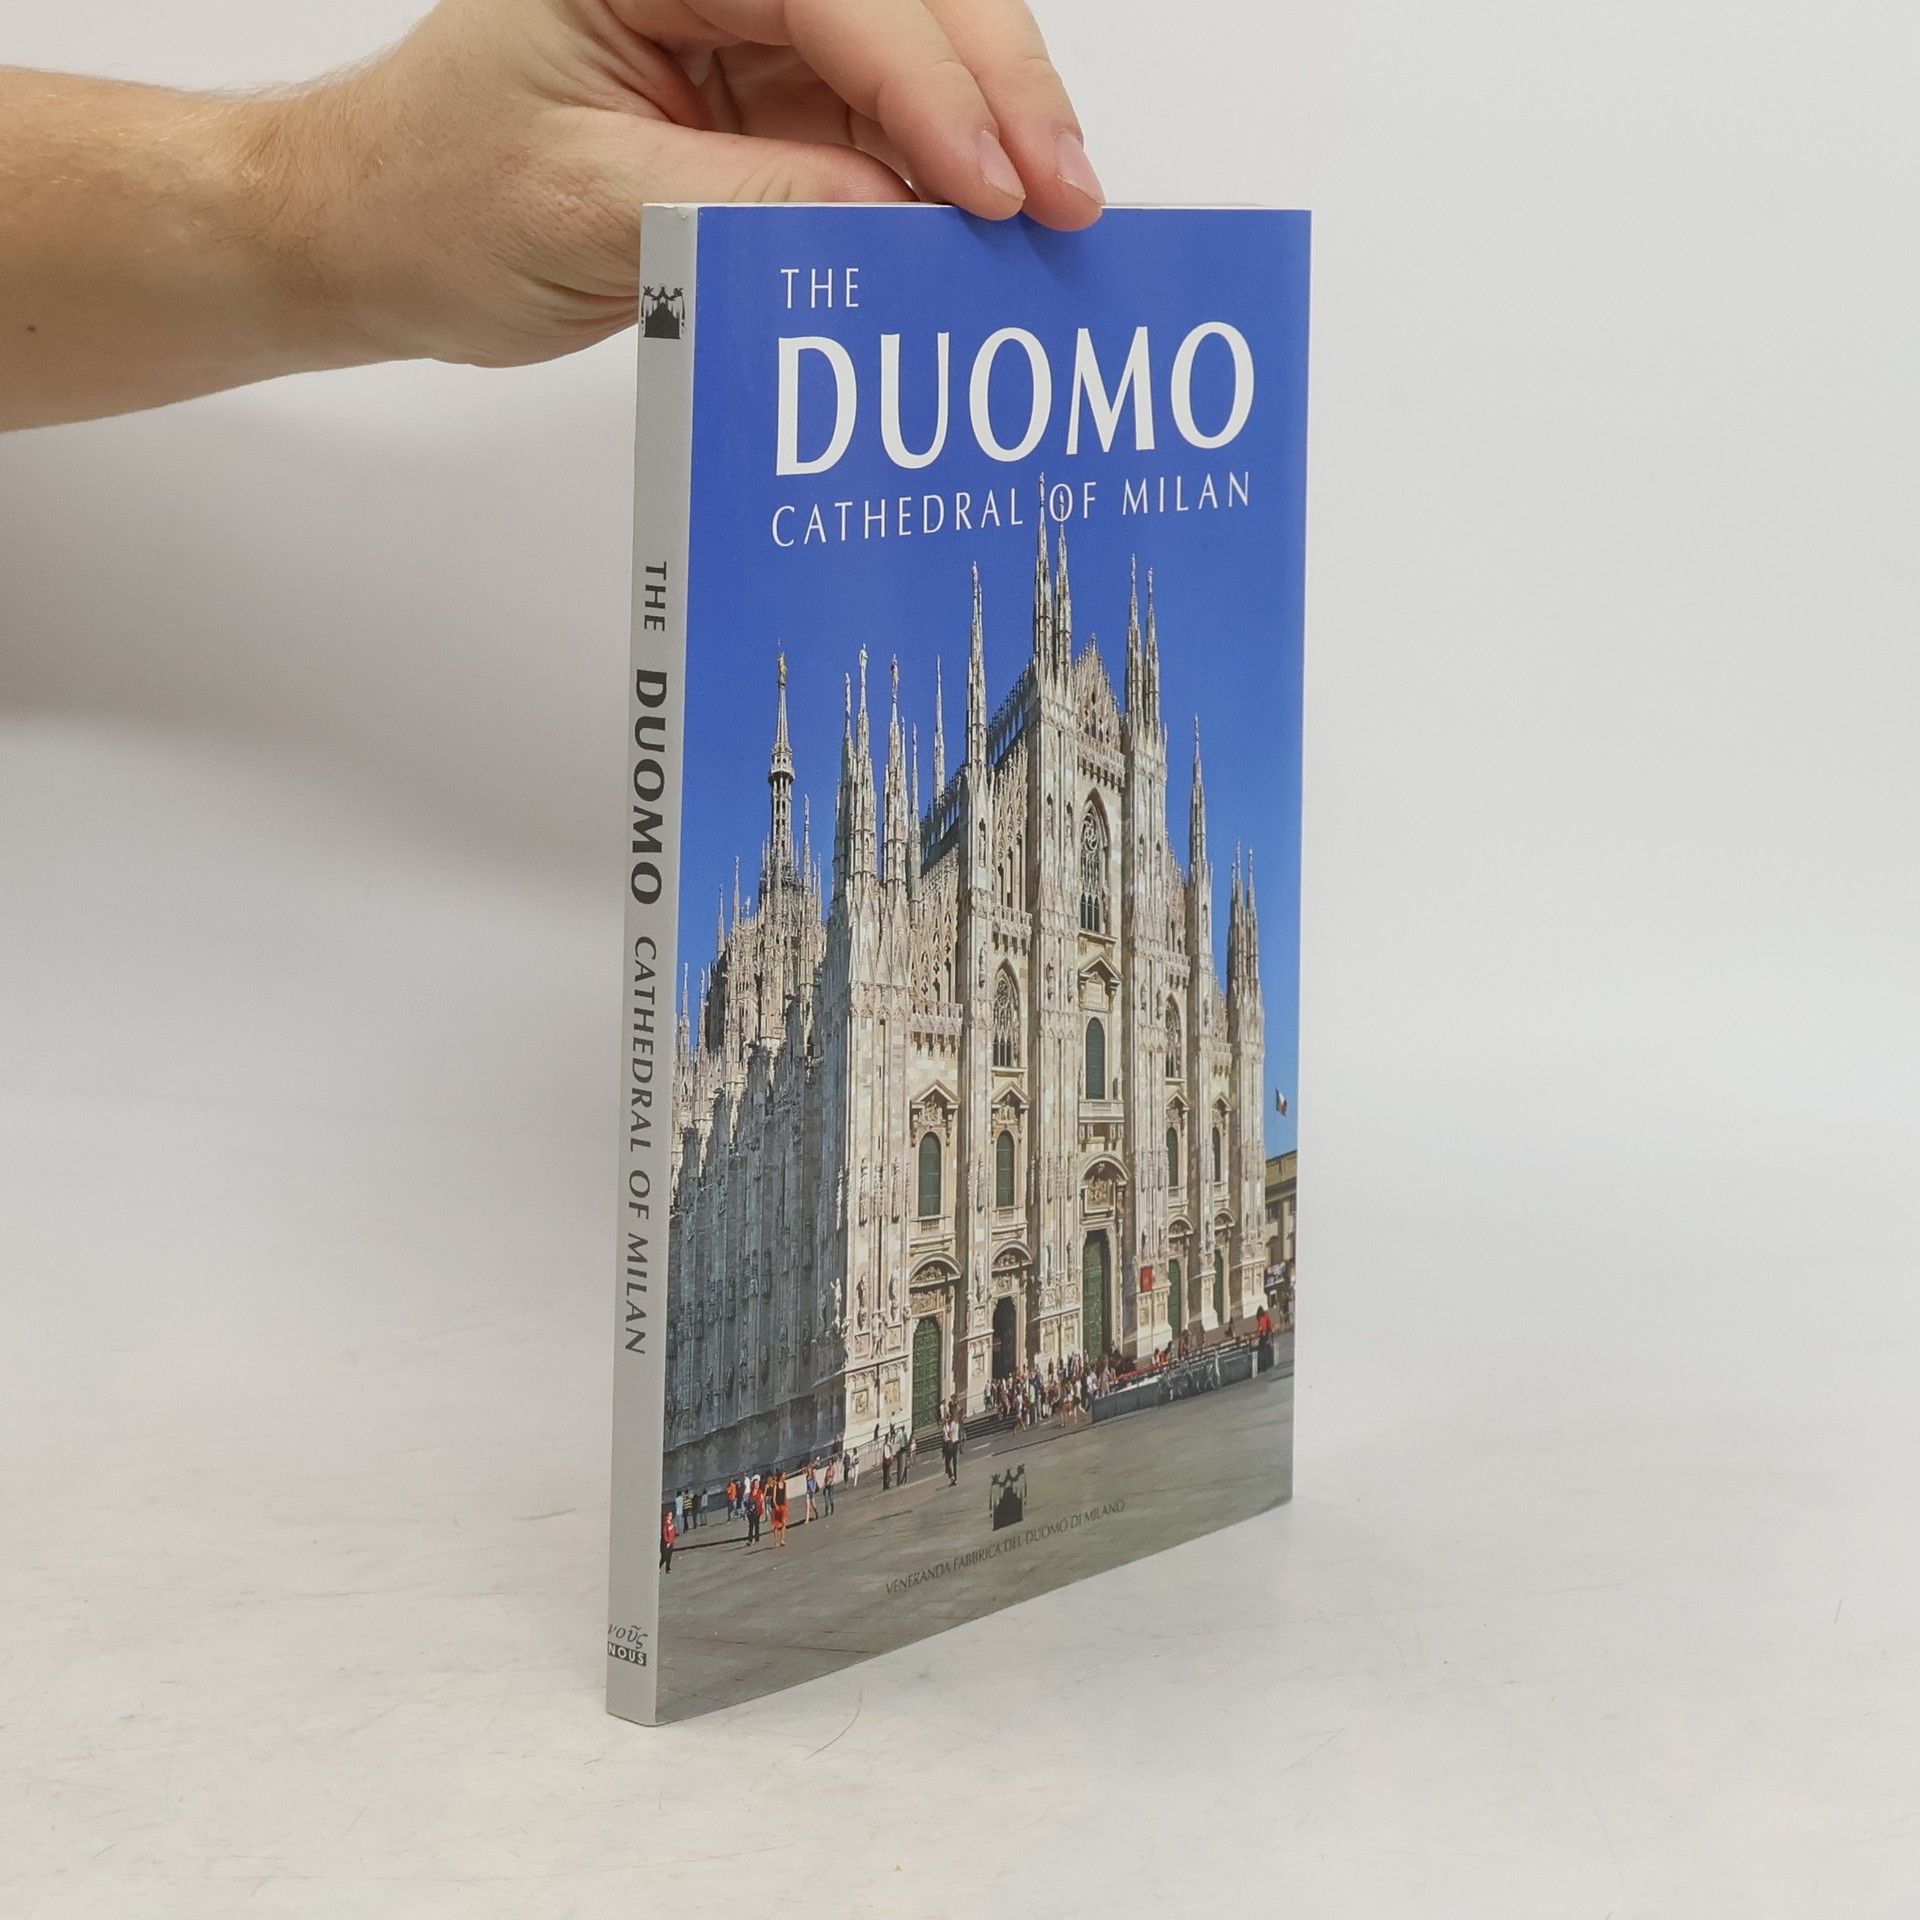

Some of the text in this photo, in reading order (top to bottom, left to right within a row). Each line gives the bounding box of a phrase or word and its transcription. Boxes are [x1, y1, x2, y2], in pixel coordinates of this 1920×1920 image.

[781, 268, 860, 309] THE
[776, 321, 1255, 476] DUOMO
[772, 471, 1250, 547] CATHEDRAL OF MILAN
[625, 561, 668, 1355] THE DUOMO CATHEDRAL OF MILAN
[886, 1498, 1126, 1595] VENERANDA FABBRICA DEL DUOMO DI MILANO
[608, 1642, 646, 1666] NOUS
